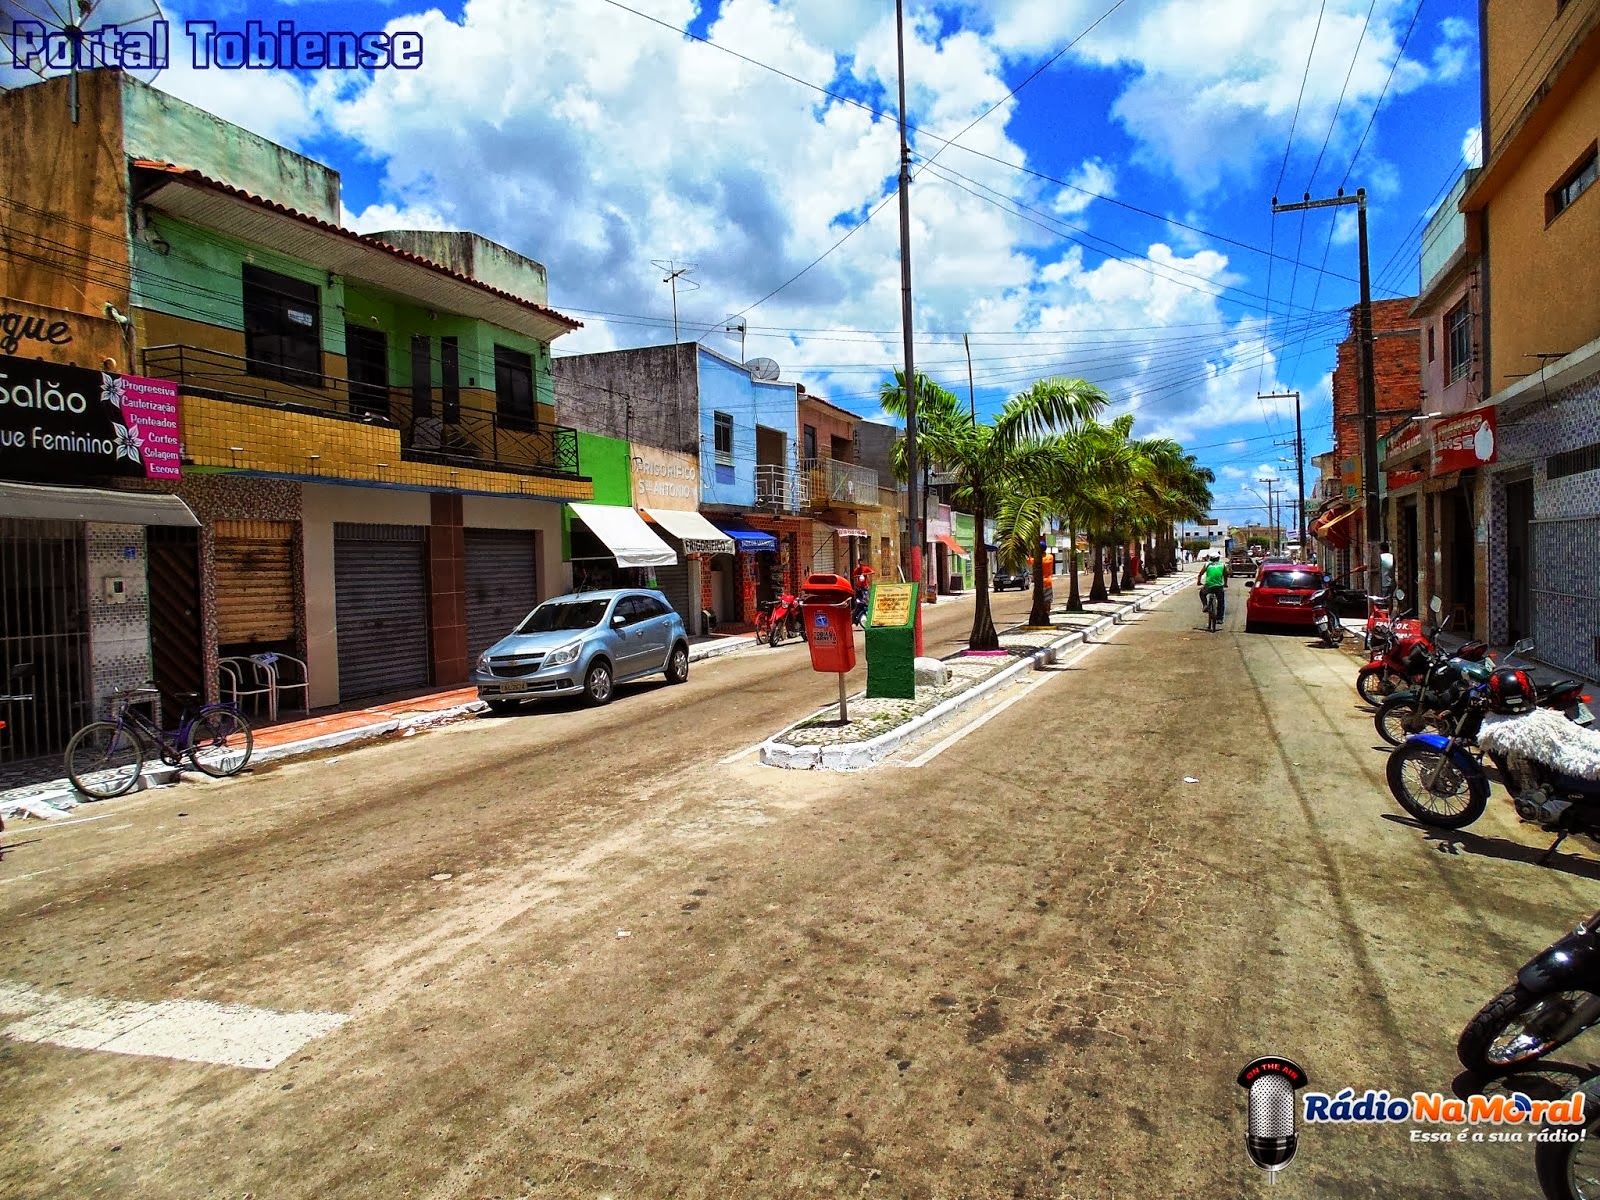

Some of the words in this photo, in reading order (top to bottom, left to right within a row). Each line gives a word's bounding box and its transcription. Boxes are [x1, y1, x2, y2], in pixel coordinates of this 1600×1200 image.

[0, 312, 73, 355] gue
[0, 373, 87, 414] Salão
[122, 380, 175, 397] Progressiva
[121, 395, 176, 414] Cauterização
[130, 413, 177, 429] Penteados
[32, 426, 114, 455] Feminino
[148, 432, 178, 445] Cortes
[150, 462, 180, 475] Escova
